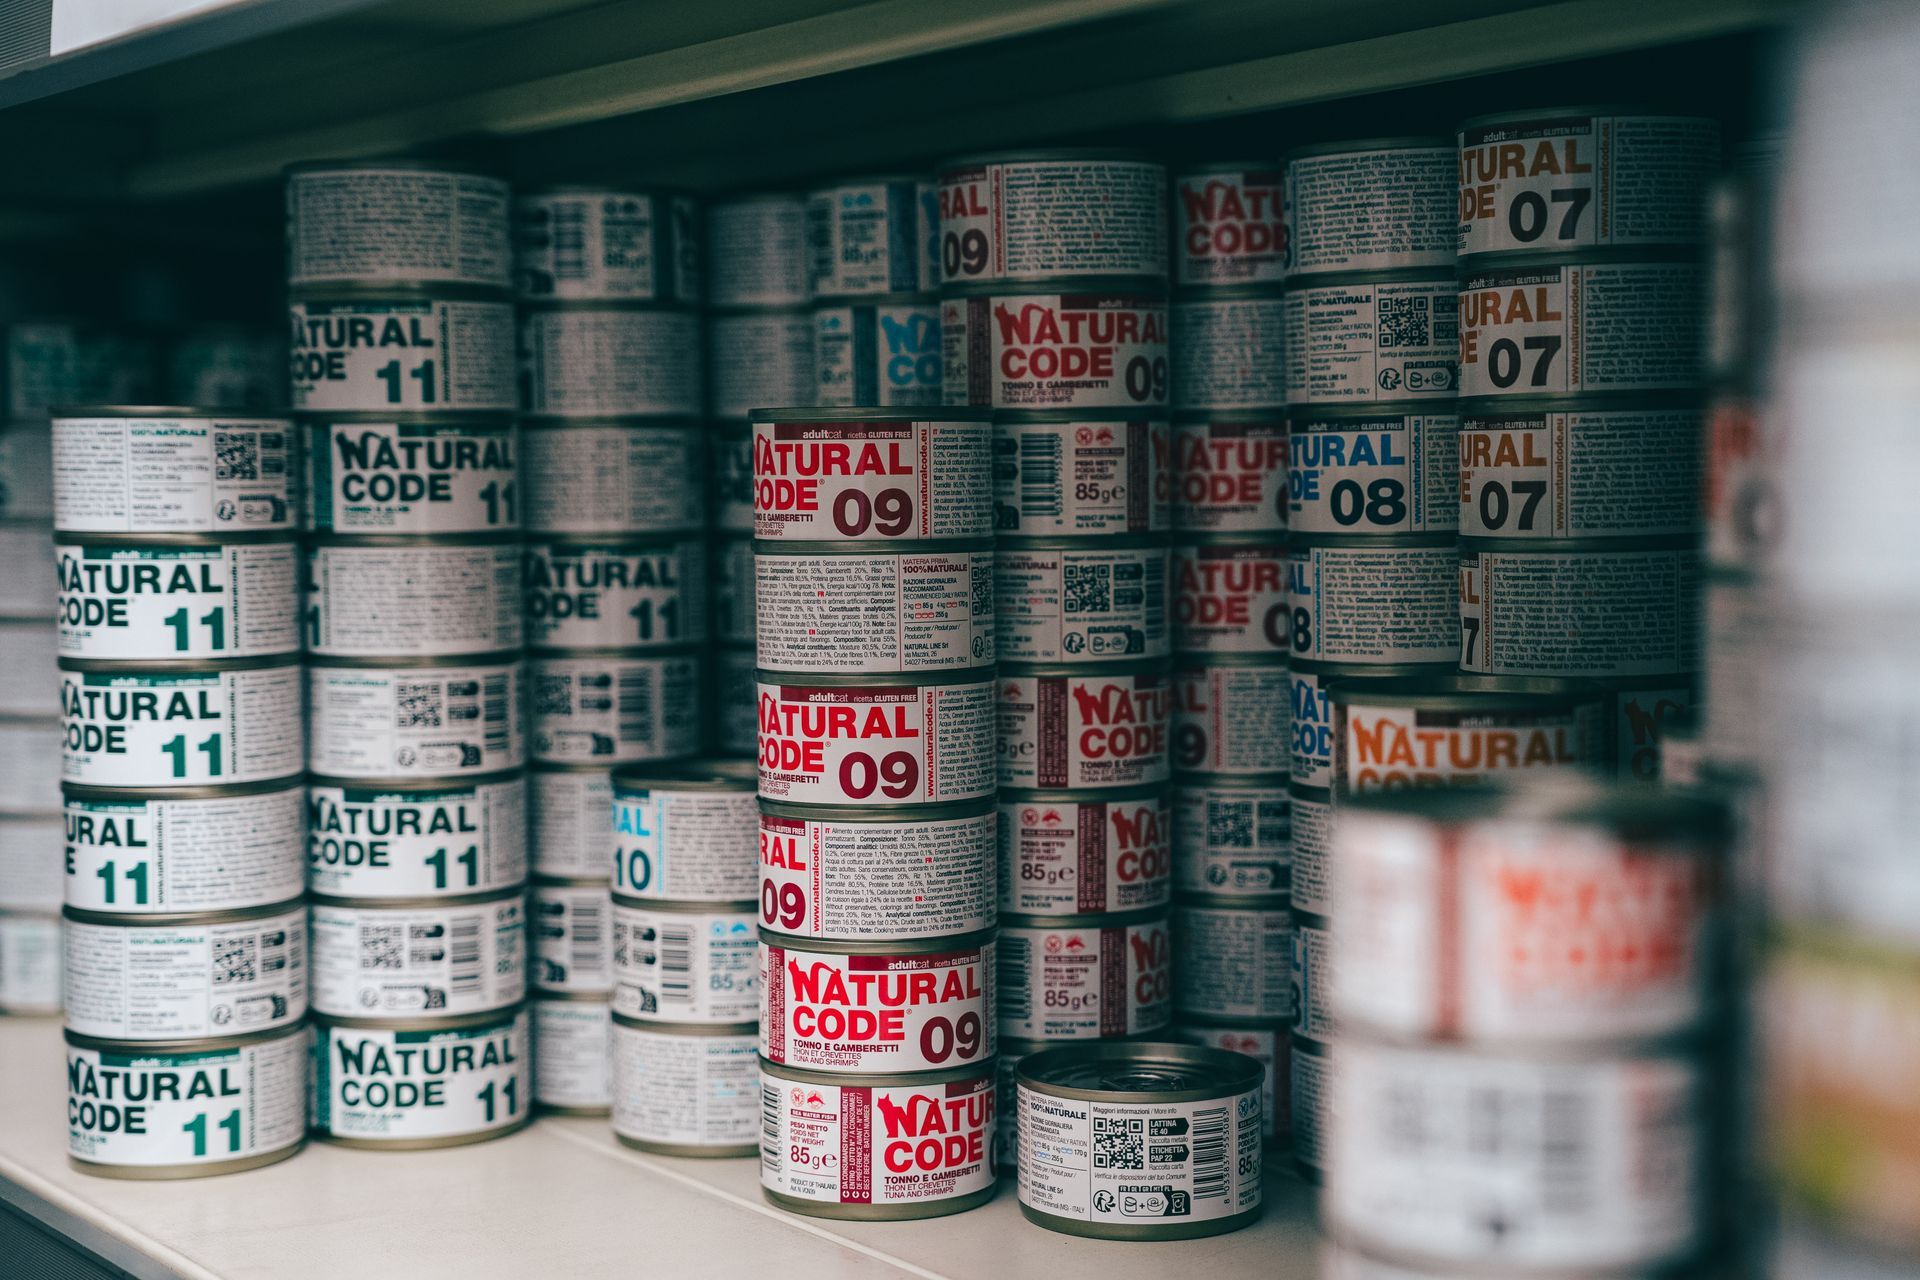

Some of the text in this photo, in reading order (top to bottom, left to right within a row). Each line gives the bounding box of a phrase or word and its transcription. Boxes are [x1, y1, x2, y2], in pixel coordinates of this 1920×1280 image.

[1483, 126, 1590, 143] adultcat GLUTEN FREE
[1509, 187, 1591, 243] 07
[944, 228, 988, 278] 09
[1516, 274, 1561, 285] GLUTEN FREE
[995, 302, 1168, 345] NATURAL
[1571, 271, 1580, 385] www.naturalcode.eu
[1001, 346, 1113, 378] CODE
[1488, 335, 1561, 389] 07
[376, 360, 435, 403] 11
[1046, 379, 1109, 390] GAMBERETTI
[1125, 355, 1168, 401] 09
[803, 429, 911, 439] adultcat GLUTEN FREE
[1308, 422, 1403, 432] adultcat GLUTEN FREE
[1504, 420, 1545, 430] GLUTEN FREE
[336, 430, 515, 470] NATURAL
[343, 474, 451, 502] CODE
[921, 429, 929, 536] www.naturalcode.eu
[1556, 418, 1564, 531] www.naturalcode.eu
[480, 480, 515, 524] 11
[1075, 483, 1100, 501] 85
[1330, 478, 1406, 526] 08
[1479, 480, 1547, 531] 07
[767, 513, 813, 522] GAMBERETTI
[833, 488, 914, 537] 09
[902, 564, 968, 574] 100%NATURALE
[164, 607, 225, 650] 11
[630, 598, 676, 639] 11
[1463, 616, 1480, 666] 7
[808, 692, 917, 703] adultcat ricetta GLUTEN FREE
[162, 733, 222, 778] 11
[757, 737, 825, 773] CODE
[1080, 727, 1166, 758] CODE
[1352, 713, 1575, 769] NATURAL
[773, 774, 819, 784] GAMBERETTI
[839, 751, 919, 800] 09
[792, 827, 805, 836] FREE
[425, 845, 477, 889] 11
[760, 831, 806, 872] RAL
[97, 861, 148, 904] 11
[615, 847, 651, 890] 10
[812, 827, 820, 932] www.naturalcode.eu
[1021, 862, 1046, 881] 85
[762, 878, 806, 930] 09
[888, 954, 980, 970] adultcat ricetta GLUTEN FREE
[788, 957, 982, 1007] NATURAL
[1044, 990, 1070, 1007] 85
[793, 1005, 905, 1041] CODE
[920, 1011, 982, 1064] 09
[337, 1036, 516, 1076] NATURAL
[793, 1039, 899, 1053] TONNO E GAMBERETTI
[793, 1047, 862, 1060] THON ET CREVETTES
[793, 1054, 859, 1067] TUNA AND SHRIMPS
[68, 1058, 241, 1101] NATURAL
[342, 1081, 444, 1108] CODE
[478, 1076, 516, 1122] 11
[877, 1090, 996, 1139] NATUR
[1030, 1102, 1087, 1120] 100%NATURALE
[1092, 1106, 1116, 1115] Maggiori
[1116, 1107, 1150, 1115] informazioni
[68, 1101, 147, 1134] CODE
[790, 1121, 829, 1132] PESO NETTO
[791, 1109, 835, 1121] SEA WATER FISH
[1150, 1120, 1177, 1128] LATTINA
[183, 1109, 241, 1156] 11
[790, 1128, 819, 1138] POIDS NET
[790, 1135, 824, 1147] NET WEIGHT
[1069, 1138, 1088, 1147] RATION
[1150, 1127, 1168, 1136] FE 40
[791, 1145, 820, 1170] 85 g
[884, 1131, 984, 1174] CODE
[1150, 1146, 1185, 1155] ETICHETTA
[1238, 1155, 1252, 1176] 85
[790, 1178, 808, 1187] PRODUCT
[815, 1181, 838, 1190] THAILAND
[884, 1164, 981, 1185] TONNO E GAMBERETTI
[884, 1178, 956, 1192] THON ET CREVETTES
[1118, 1172, 1147, 1181] disposizioni
[884, 1186, 954, 1199] TUNA AND SHRIMPS
[1072, 1206, 1085, 1214] ITALY
